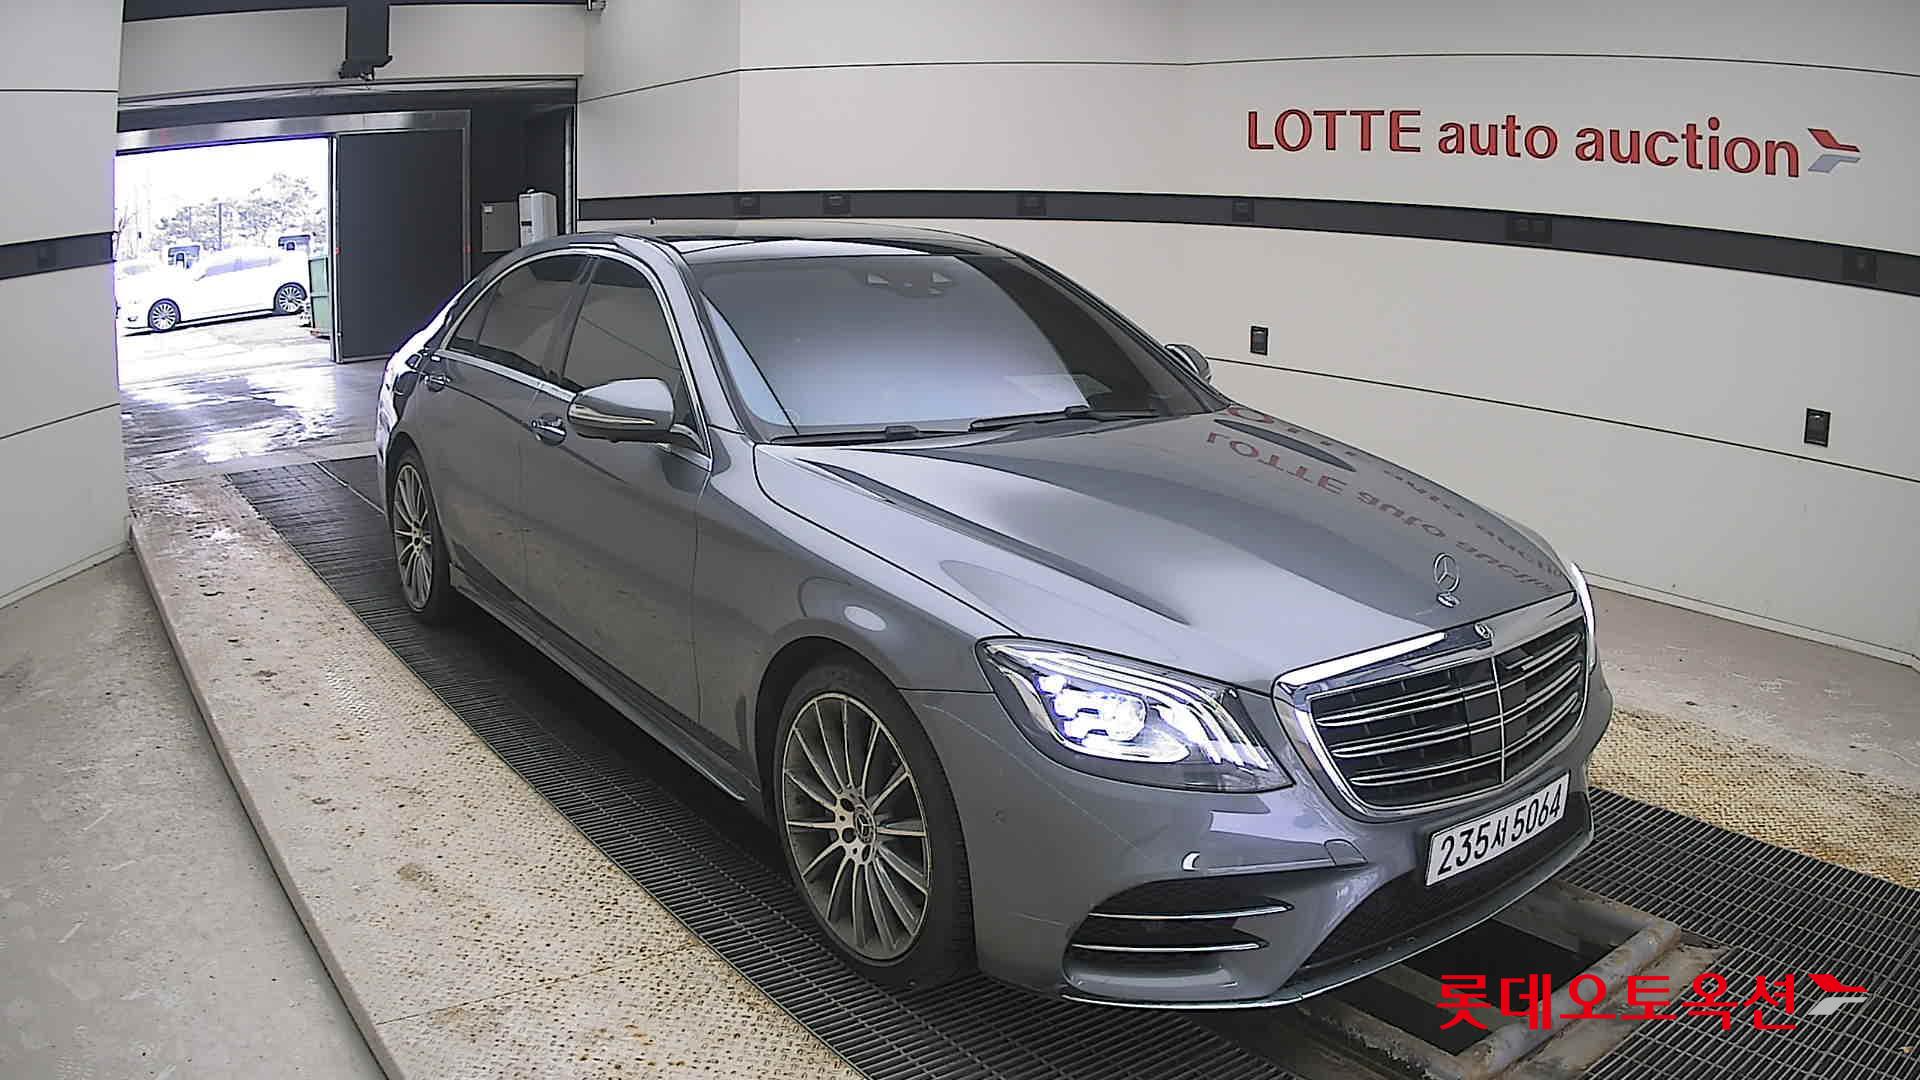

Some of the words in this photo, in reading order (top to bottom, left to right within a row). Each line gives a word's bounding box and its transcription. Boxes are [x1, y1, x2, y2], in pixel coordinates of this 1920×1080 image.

[1247, 109, 1421, 153] LOTTE
[1438, 115, 1558, 159] auto
[1575, 117, 1800, 177] auction
